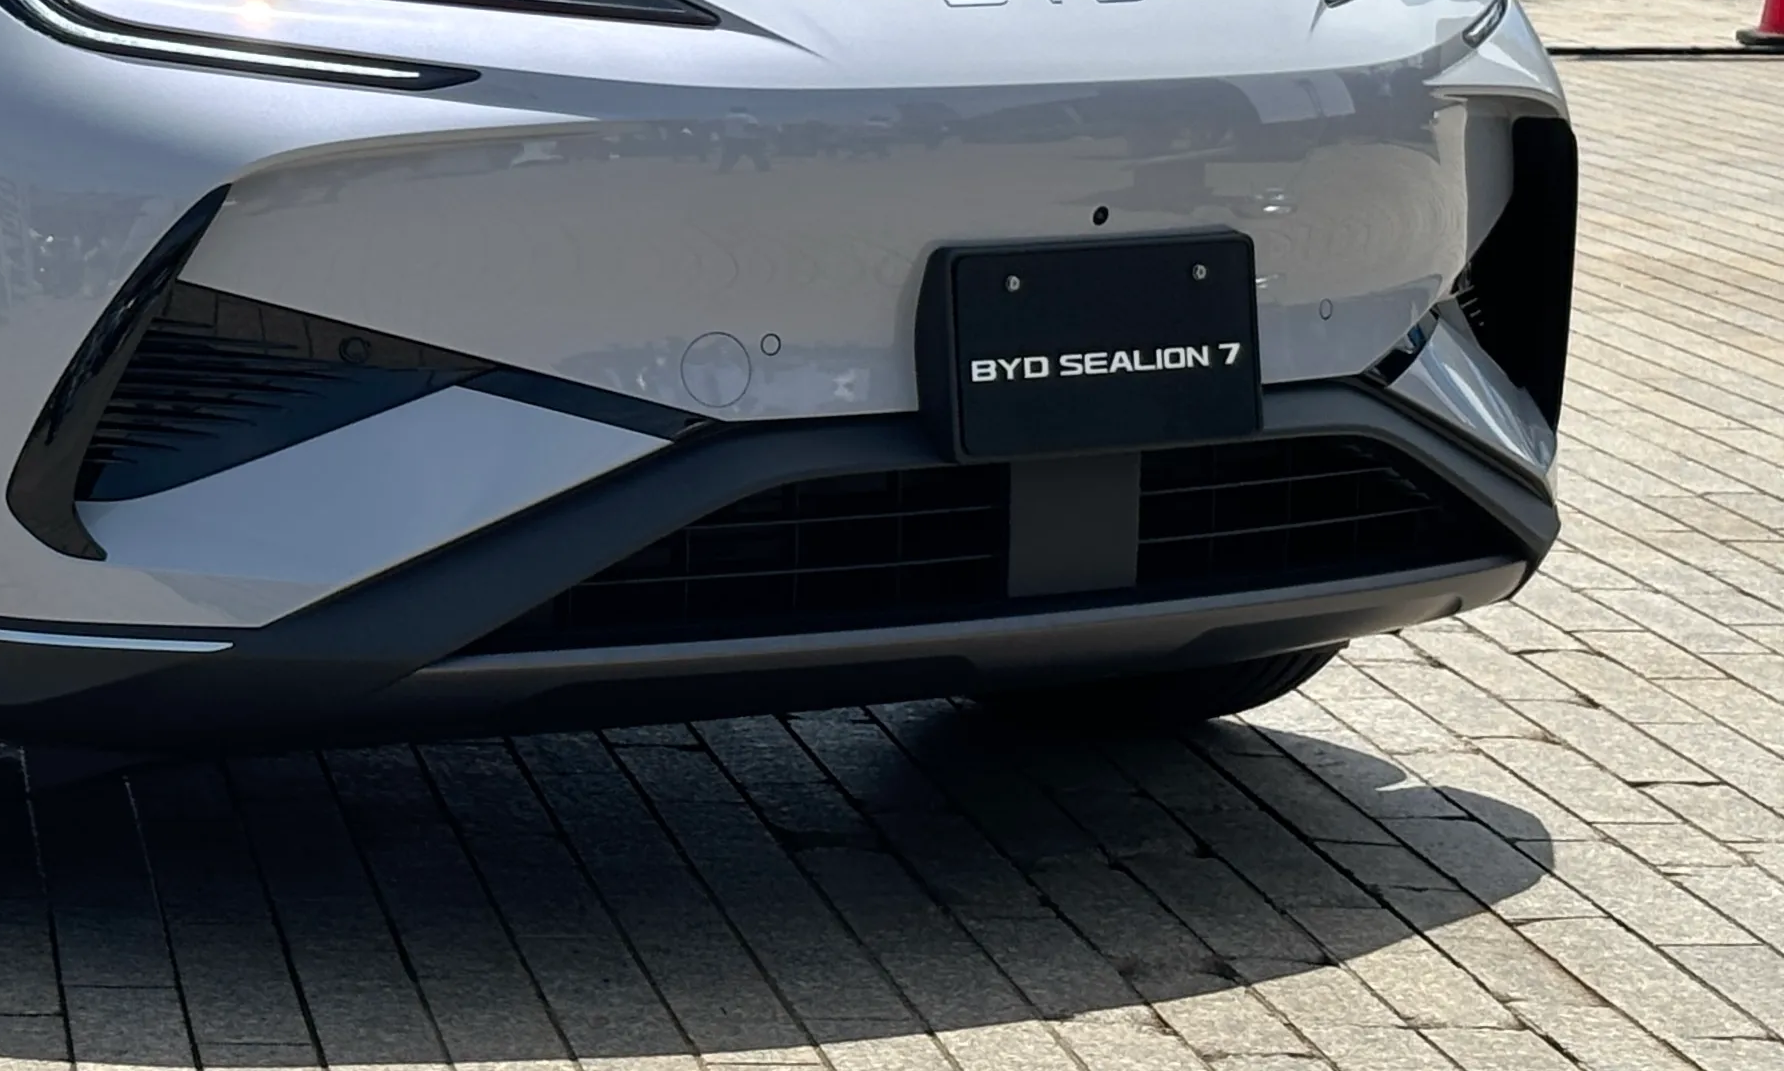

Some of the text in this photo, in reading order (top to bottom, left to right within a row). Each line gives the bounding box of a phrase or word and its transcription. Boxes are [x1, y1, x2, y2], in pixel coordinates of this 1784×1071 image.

[971, 341, 1242, 383] BYD SEALION 7
